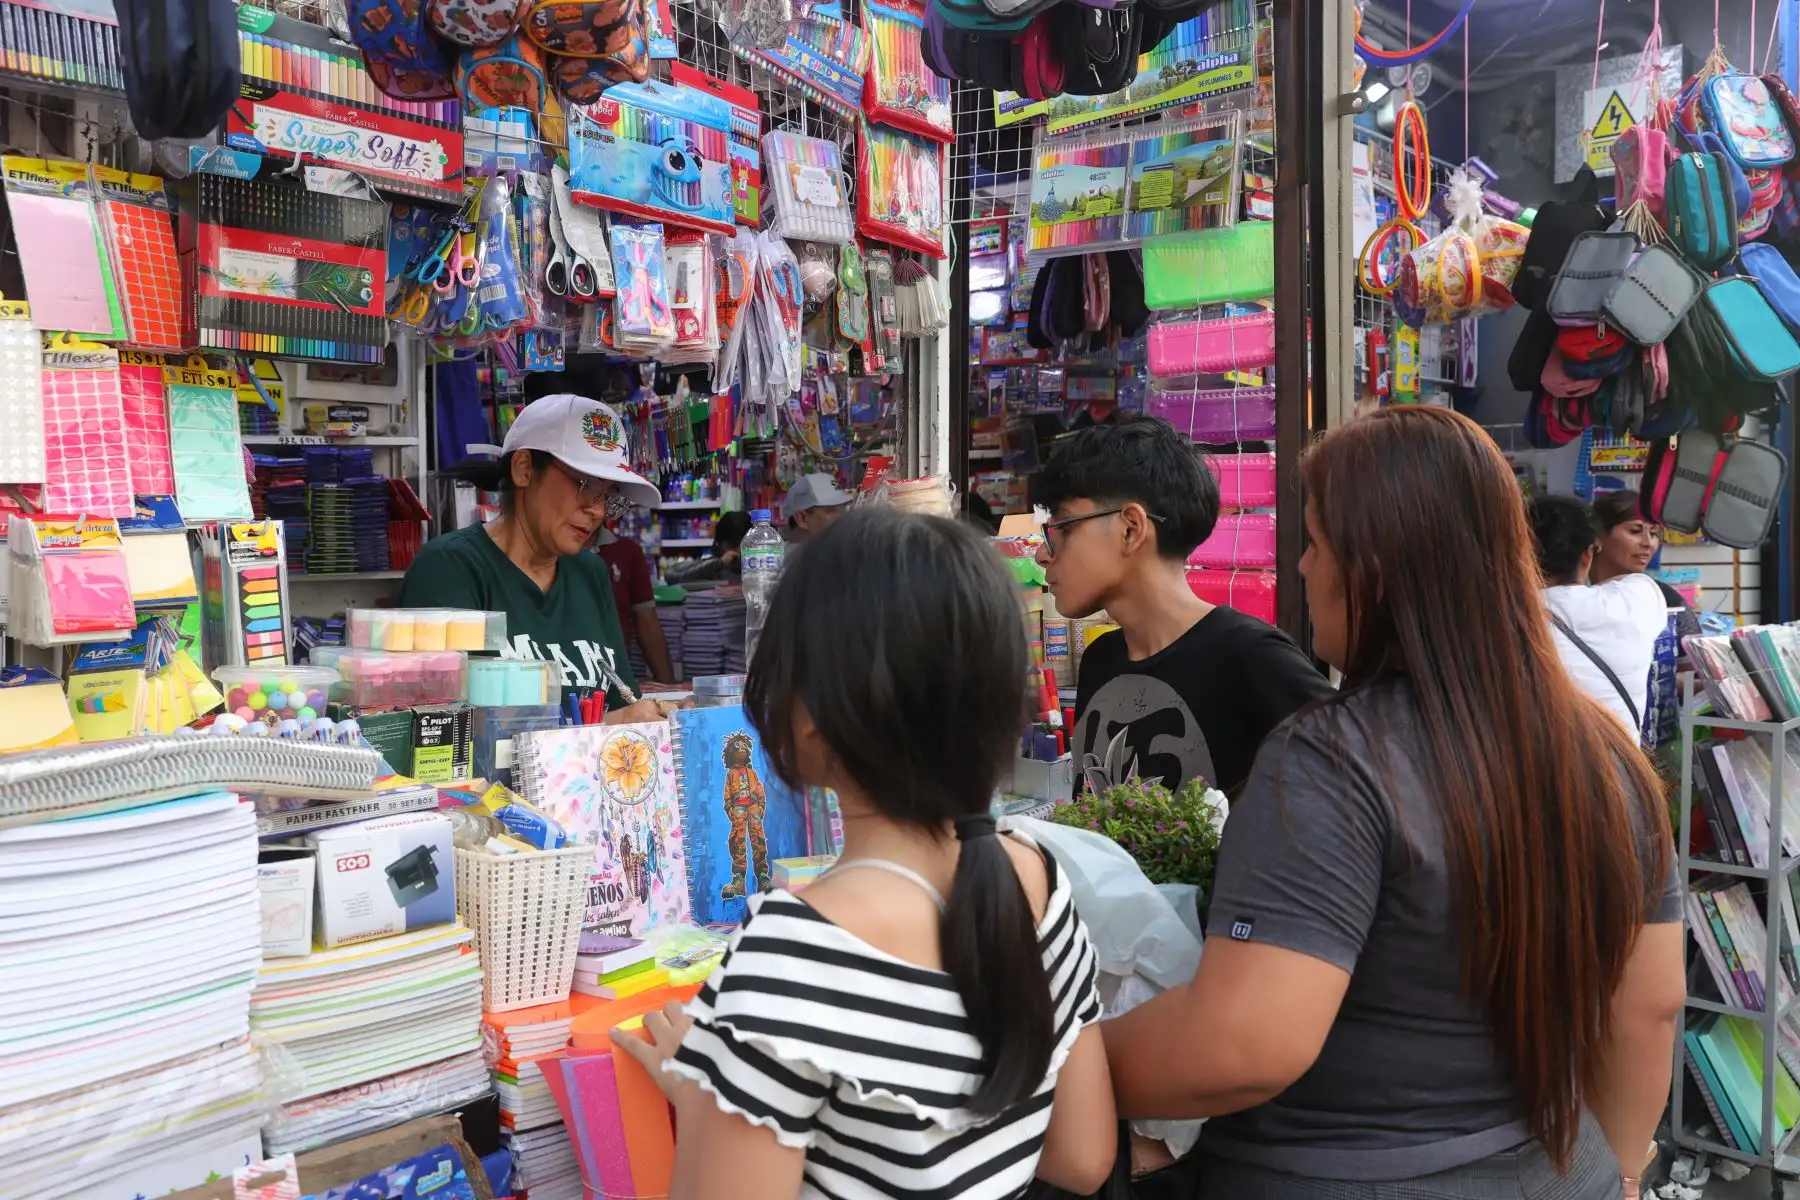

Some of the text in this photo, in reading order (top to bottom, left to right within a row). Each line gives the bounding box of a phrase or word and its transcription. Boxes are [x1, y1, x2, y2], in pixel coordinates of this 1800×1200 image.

[1196, 52, 1239, 71] alpha
[325, 110, 380, 130] FABER-CASTELL
[280, 120, 421, 170] Super Soft
[8, 169, 50, 184] ETIflex
[1040, 169, 1065, 180] alpha
[101, 179, 144, 196] ETIflex
[268, 242, 326, 260] FABER-CASTELL
[430, 717, 453, 725] PILOT
[286, 802, 381, 826] PAPER FASTENER
[337, 855, 370, 872] GOS
[336, 927, 395, 945] PERFORADOR
